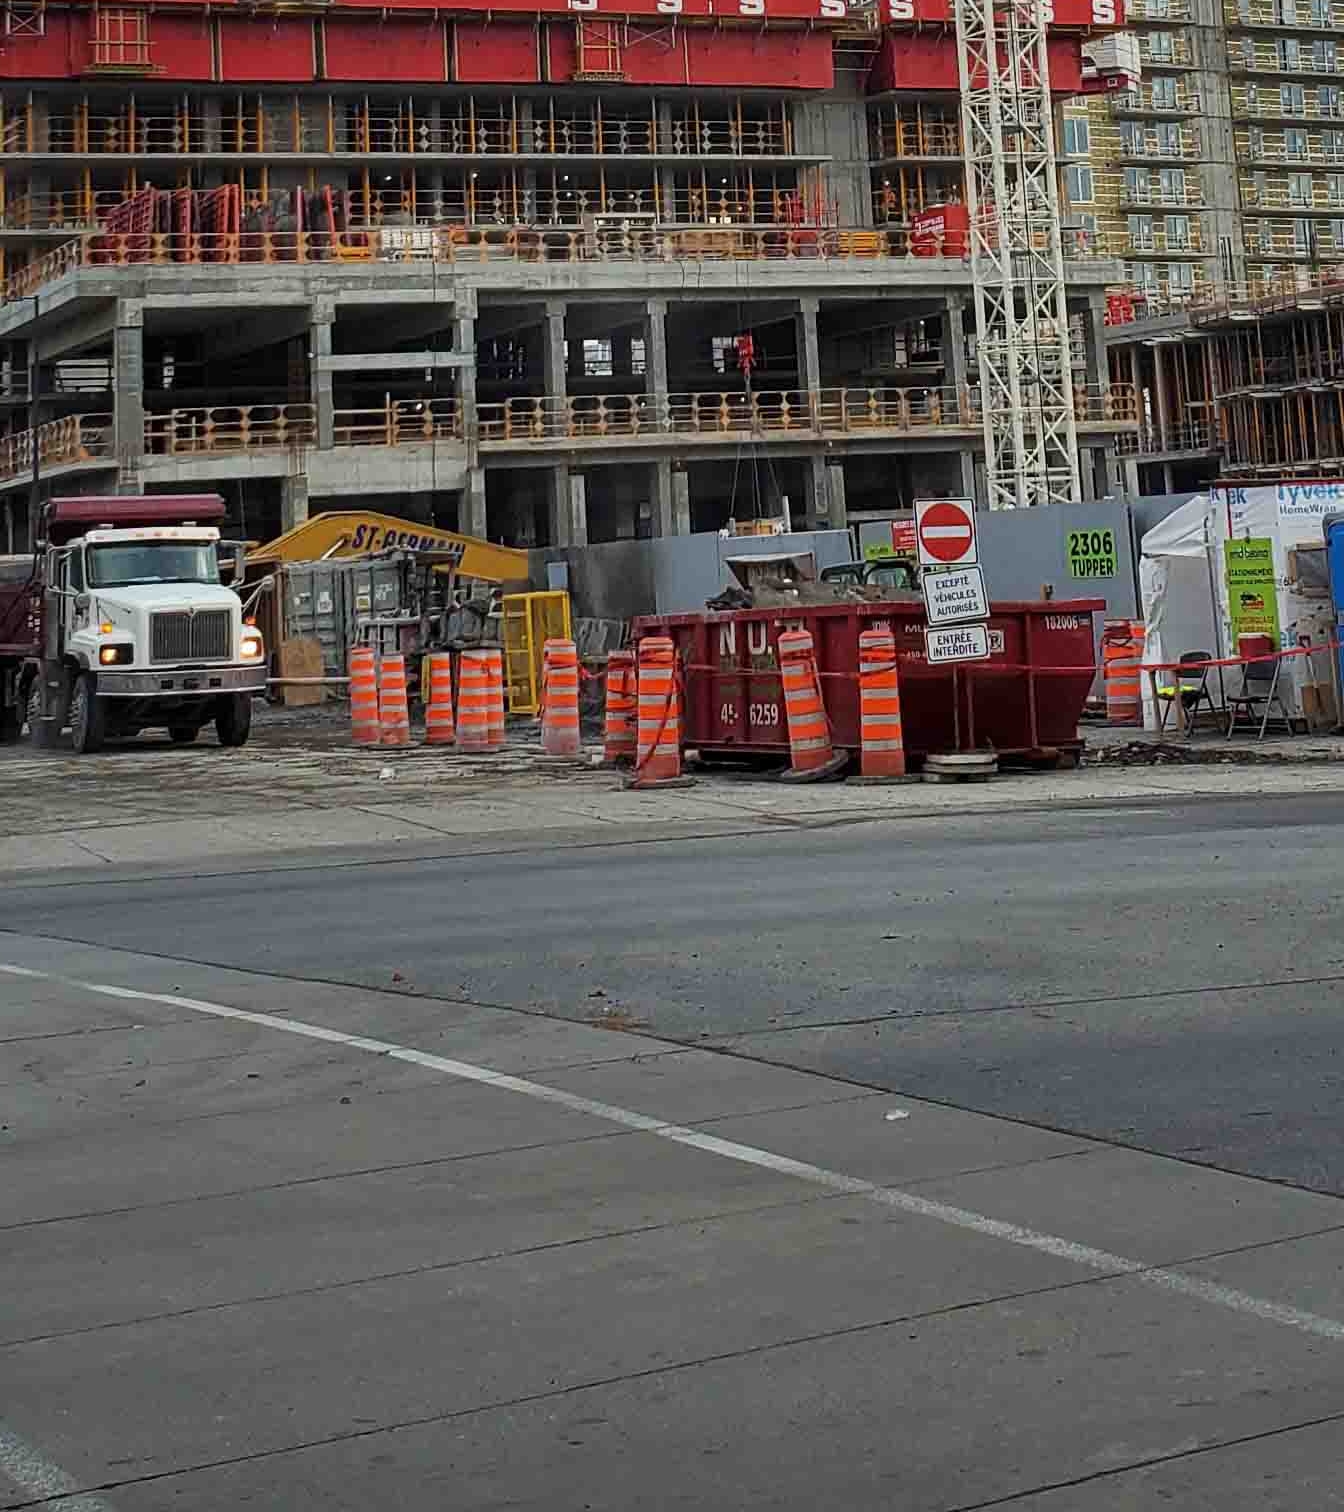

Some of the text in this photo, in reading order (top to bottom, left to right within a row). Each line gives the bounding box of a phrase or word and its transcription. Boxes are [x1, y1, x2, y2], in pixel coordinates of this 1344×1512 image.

[1092, 0, 1116, 24] S
[1070, 531, 1113, 556] 2306
[1071, 558, 1114, 577] TUPPER
[1044, 615, 1079, 630] 182006
[937, 631, 973, 645] ENTRÉE
[933, 643, 981, 657] INTERDITE
[749, 703, 779, 726] 6259
